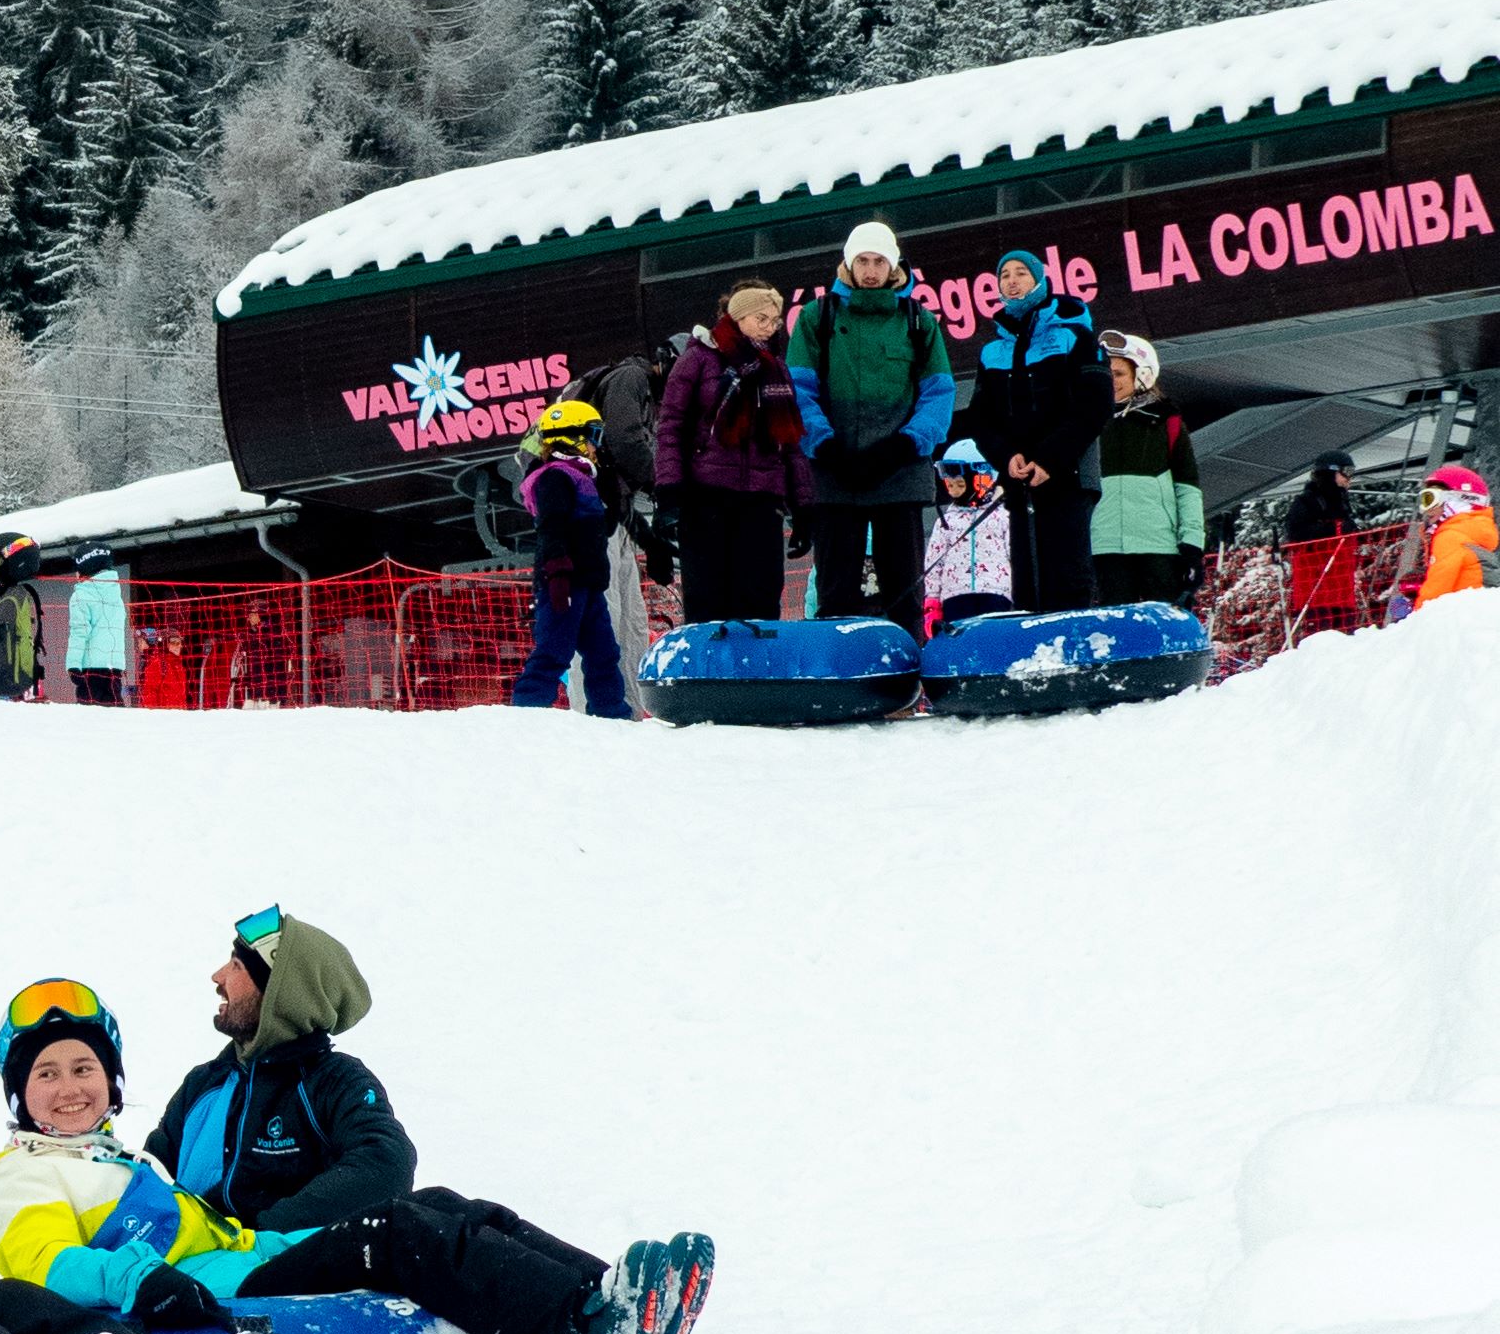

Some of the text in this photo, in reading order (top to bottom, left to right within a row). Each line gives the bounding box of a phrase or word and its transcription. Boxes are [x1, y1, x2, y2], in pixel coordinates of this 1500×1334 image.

[1123, 223, 1201, 292] LA
[1210, 173, 1495, 277] COLOMBA
[342, 353, 571, 422] VAL CENIS
[389, 397, 547, 452] VANOISE
